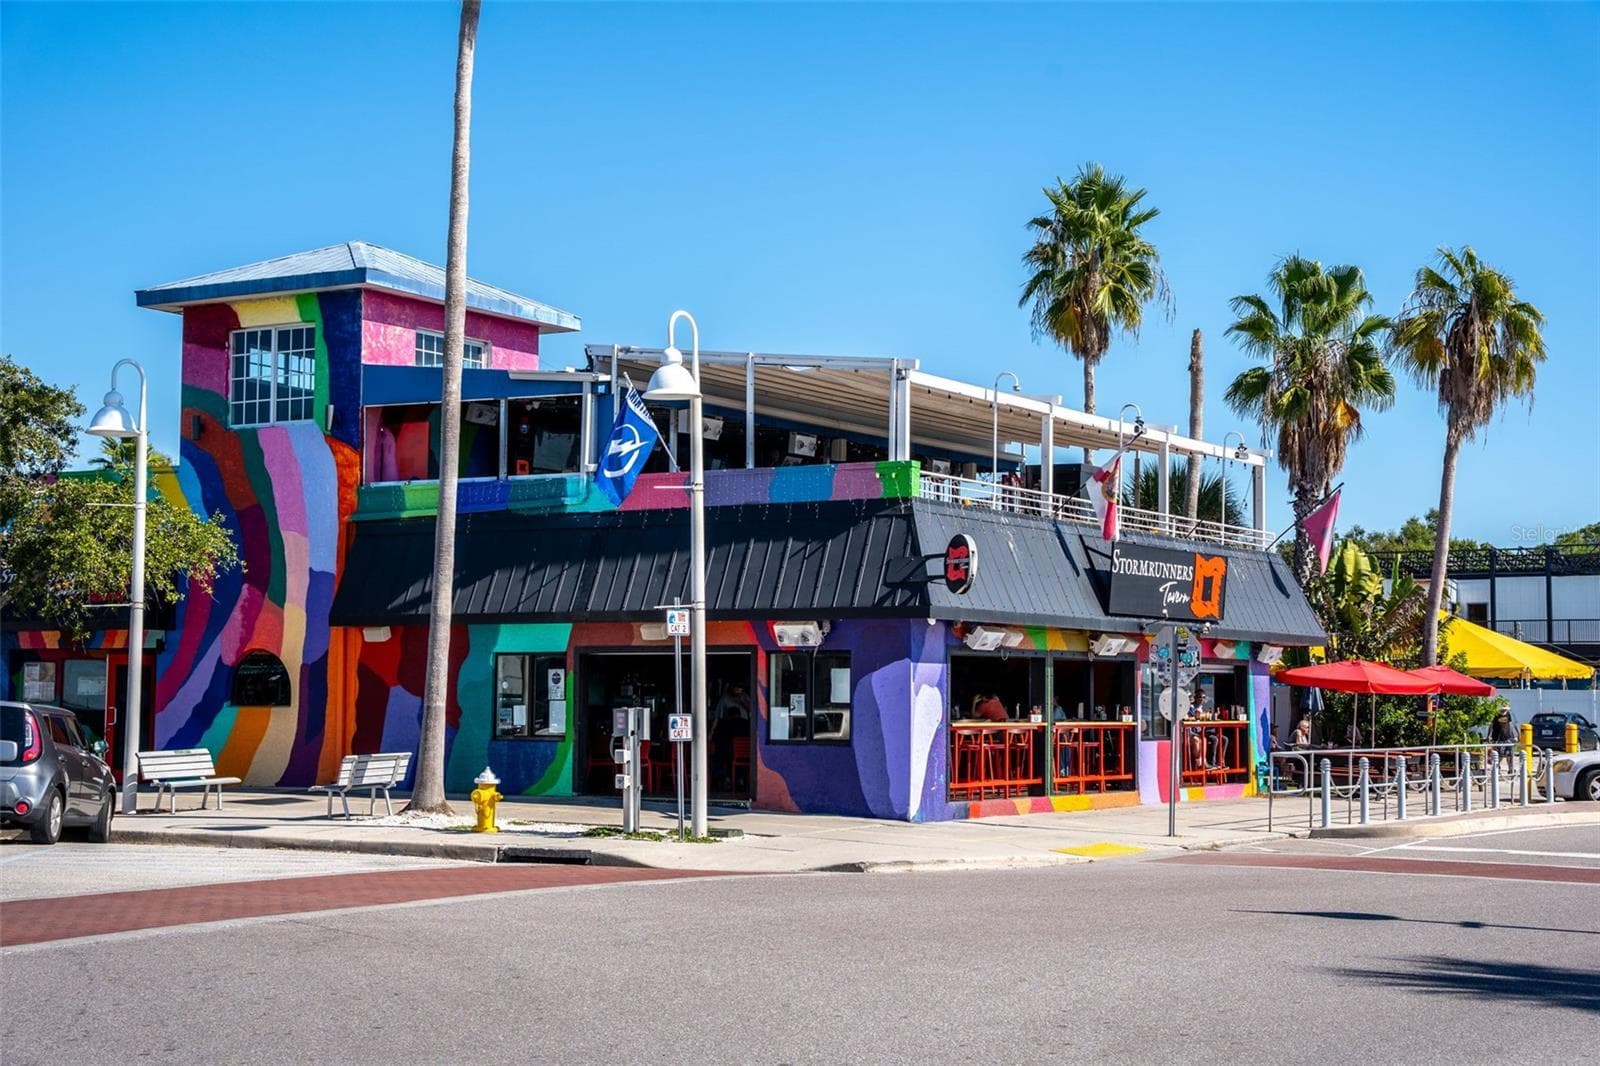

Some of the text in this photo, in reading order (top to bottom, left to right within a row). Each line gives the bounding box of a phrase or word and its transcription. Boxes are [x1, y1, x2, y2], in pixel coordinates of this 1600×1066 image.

[1112, 549, 1194, 581] STORMRUNNERS
[1159, 581, 1190, 607] Tavern
[671, 624, 687, 632] CAT 2
[673, 729, 683, 738] CAT
